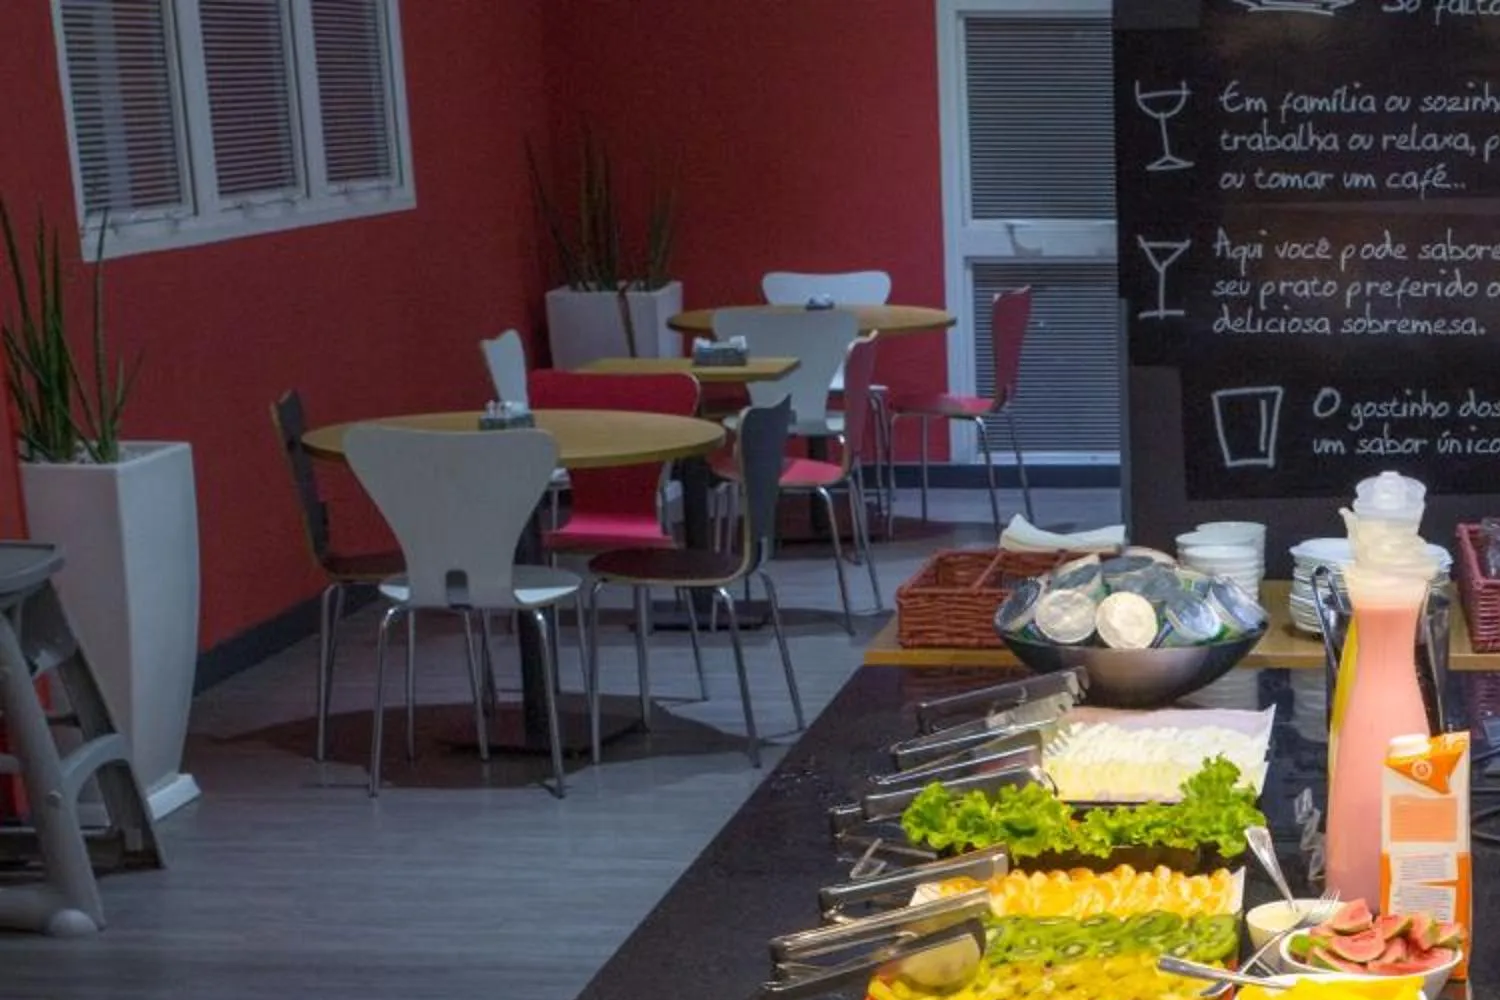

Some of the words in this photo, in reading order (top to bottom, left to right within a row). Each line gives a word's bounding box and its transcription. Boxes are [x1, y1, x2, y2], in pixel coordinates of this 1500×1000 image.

[1219, 81, 1268, 113] Em
[1279, 82, 1377, 124] família
[1385, 95, 1411, 112] ou
[1220, 118, 1340, 151] trabalha
[1349, 133, 1374, 150] ou
[1382, 123, 1476, 157] relaxa,
[1219, 173, 1246, 190] ou
[1254, 168, 1334, 189] tomar
[1343, 172, 1376, 189] um
[1213, 226, 1267, 276] Aqui
[1274, 236, 1333, 260] você
[1339, 229, 1409, 272] pode
[1212, 279, 1251, 297] seu
[1260, 276, 1338, 311] prato
[1346, 268, 1478, 309] preferido
[1212, 303, 1331, 334] deliciosa
[1340, 302, 1487, 336] sobremesa.
[1313, 386, 1341, 418] O
[1347, 388, 1449, 431] gostinho
[1313, 438, 1346, 454] um
[1356, 422, 1428, 455] sabor
